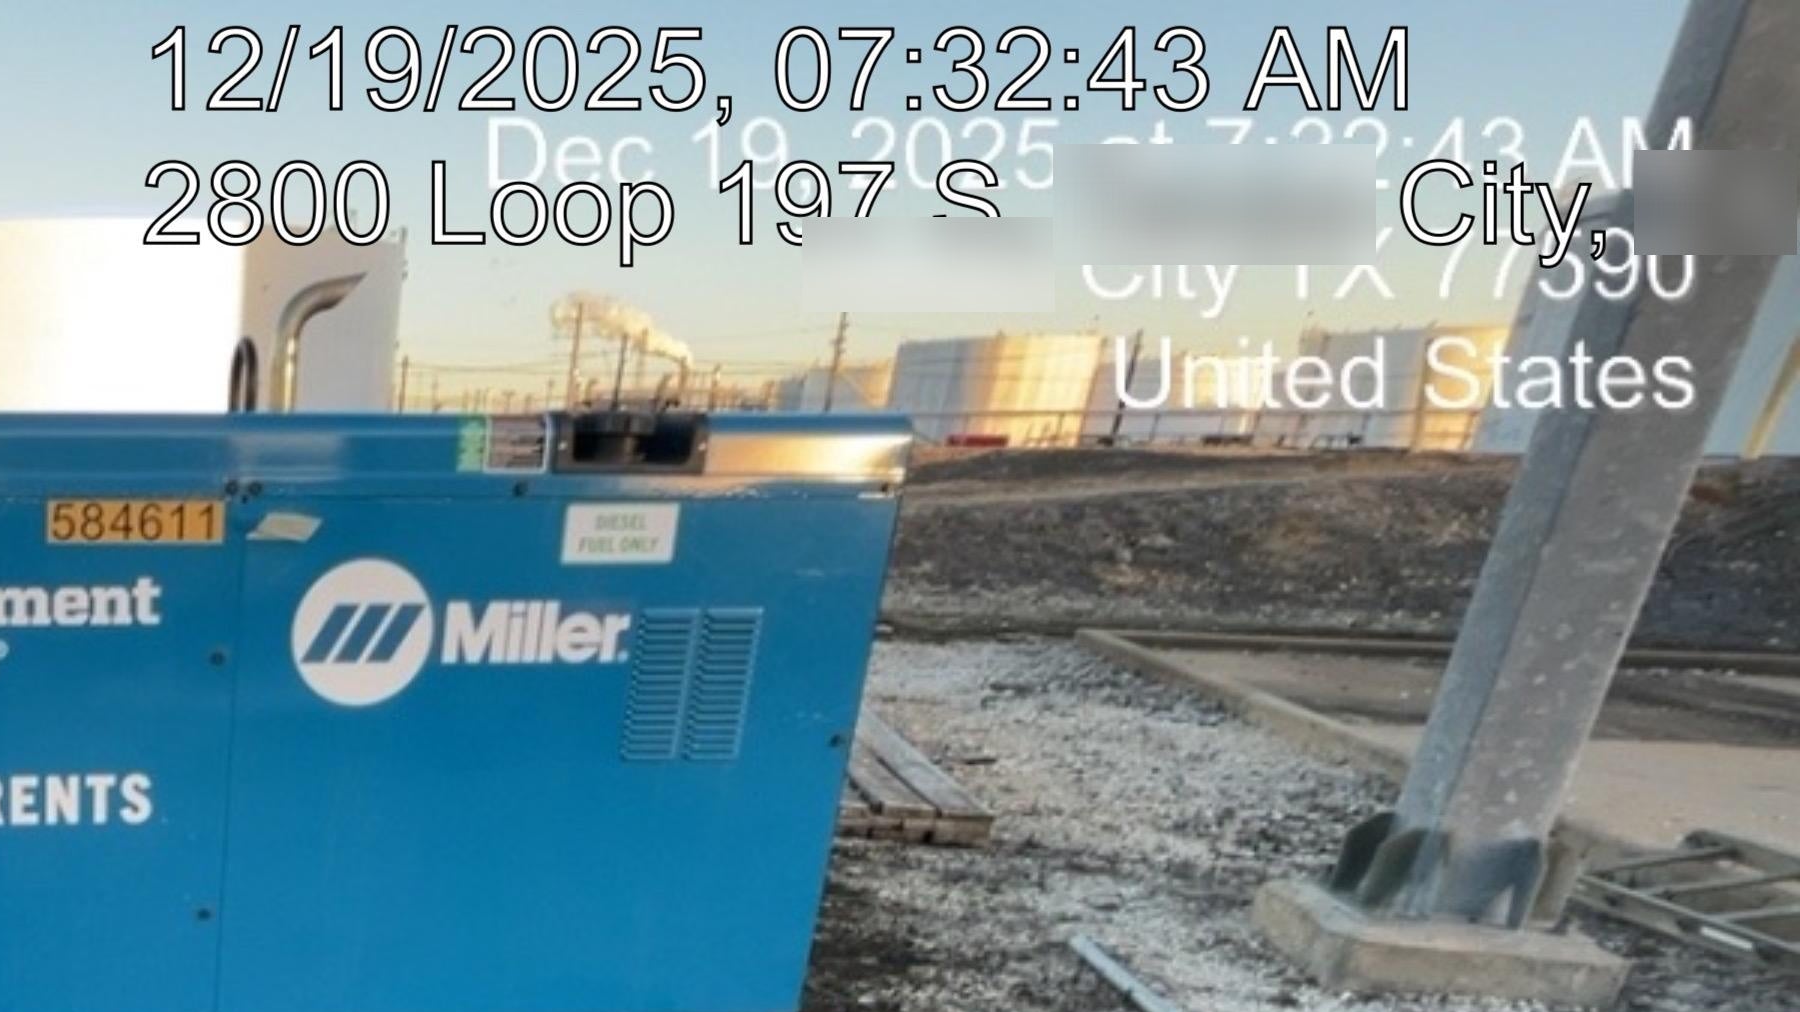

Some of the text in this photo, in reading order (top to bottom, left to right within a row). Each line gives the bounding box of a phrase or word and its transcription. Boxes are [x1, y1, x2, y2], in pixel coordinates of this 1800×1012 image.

[52, 502, 215, 541] 584611
[594, 513, 648, 532] DIESEL
[577, 535, 660, 554] FUEL ONLY
